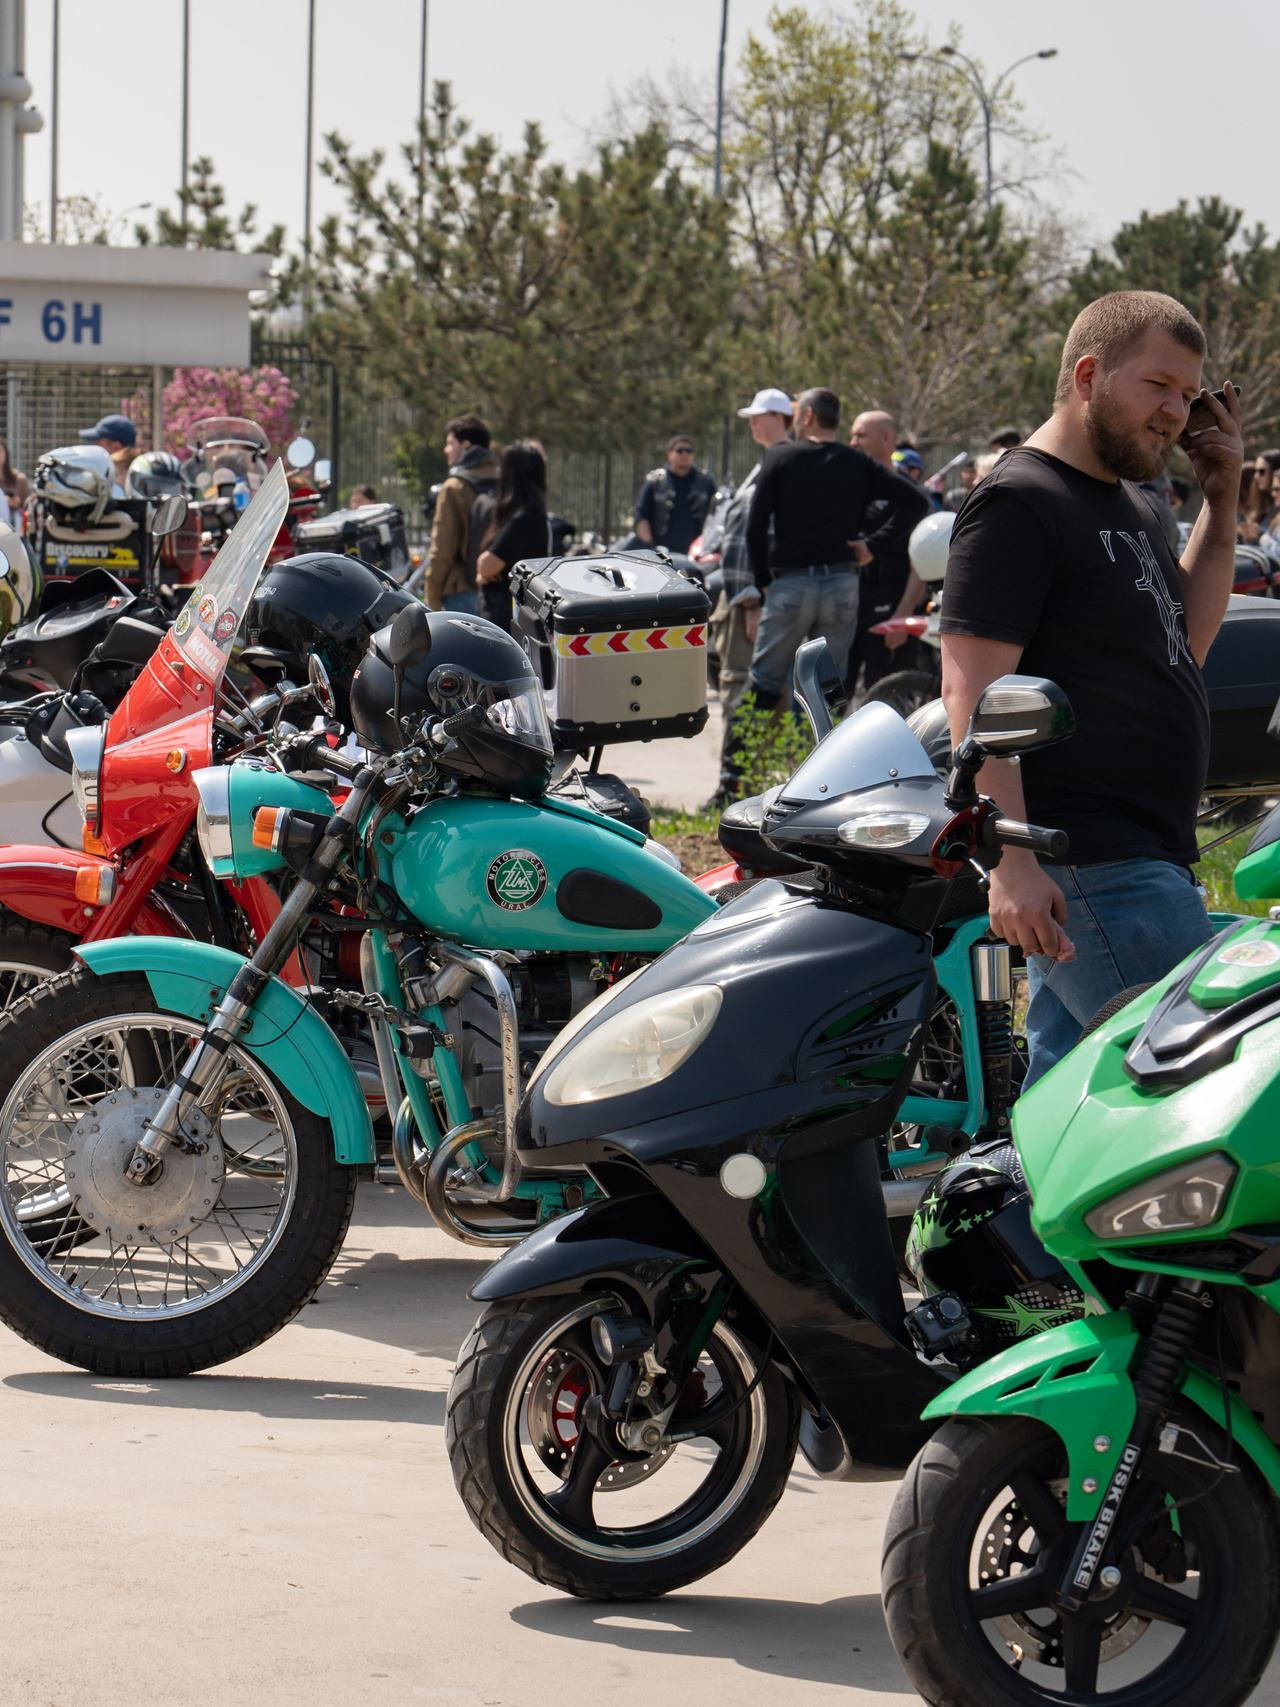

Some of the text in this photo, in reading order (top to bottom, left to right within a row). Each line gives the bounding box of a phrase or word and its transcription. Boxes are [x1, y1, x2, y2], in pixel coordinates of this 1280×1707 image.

[42, 300, 102, 344] 6H
[188, 636, 220, 673] MOTUL
[488, 851, 546, 881] MOTORCYCLES
[501, 901, 529, 910] URAL
[1077, 1450, 1137, 1586] DISK BRAKE
